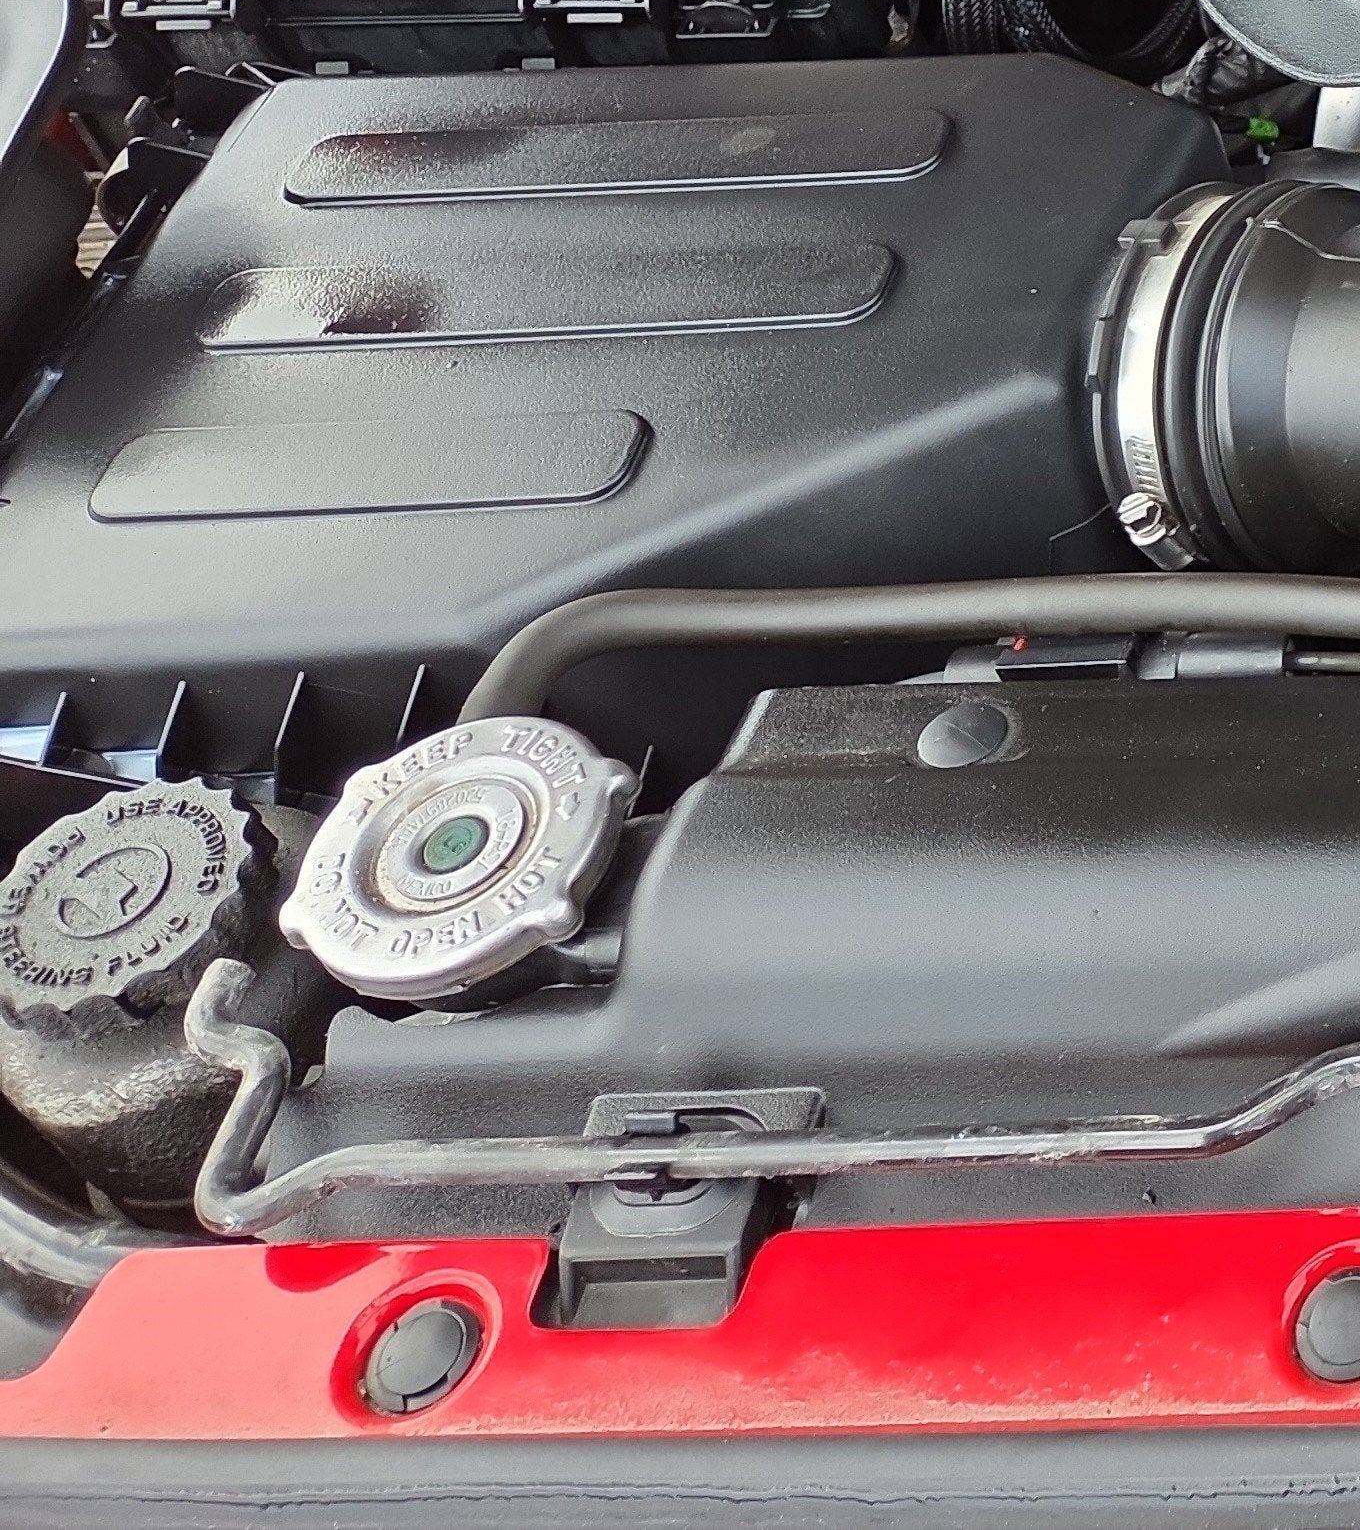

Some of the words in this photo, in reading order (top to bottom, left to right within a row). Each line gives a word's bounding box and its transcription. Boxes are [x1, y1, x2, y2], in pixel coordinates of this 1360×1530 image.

[372, 732, 473, 798] KEEP
[500, 724, 587, 789] TIGHT
[106, 796, 164, 826] USE
[166, 798, 227, 895] APPROVED
[320, 898, 380, 950] NOT
[389, 909, 484, 959] OPEN
[497, 845, 564, 916] HOT
[0, 923, 95, 987] STEERING
[107, 911, 192, 977] FLUID
